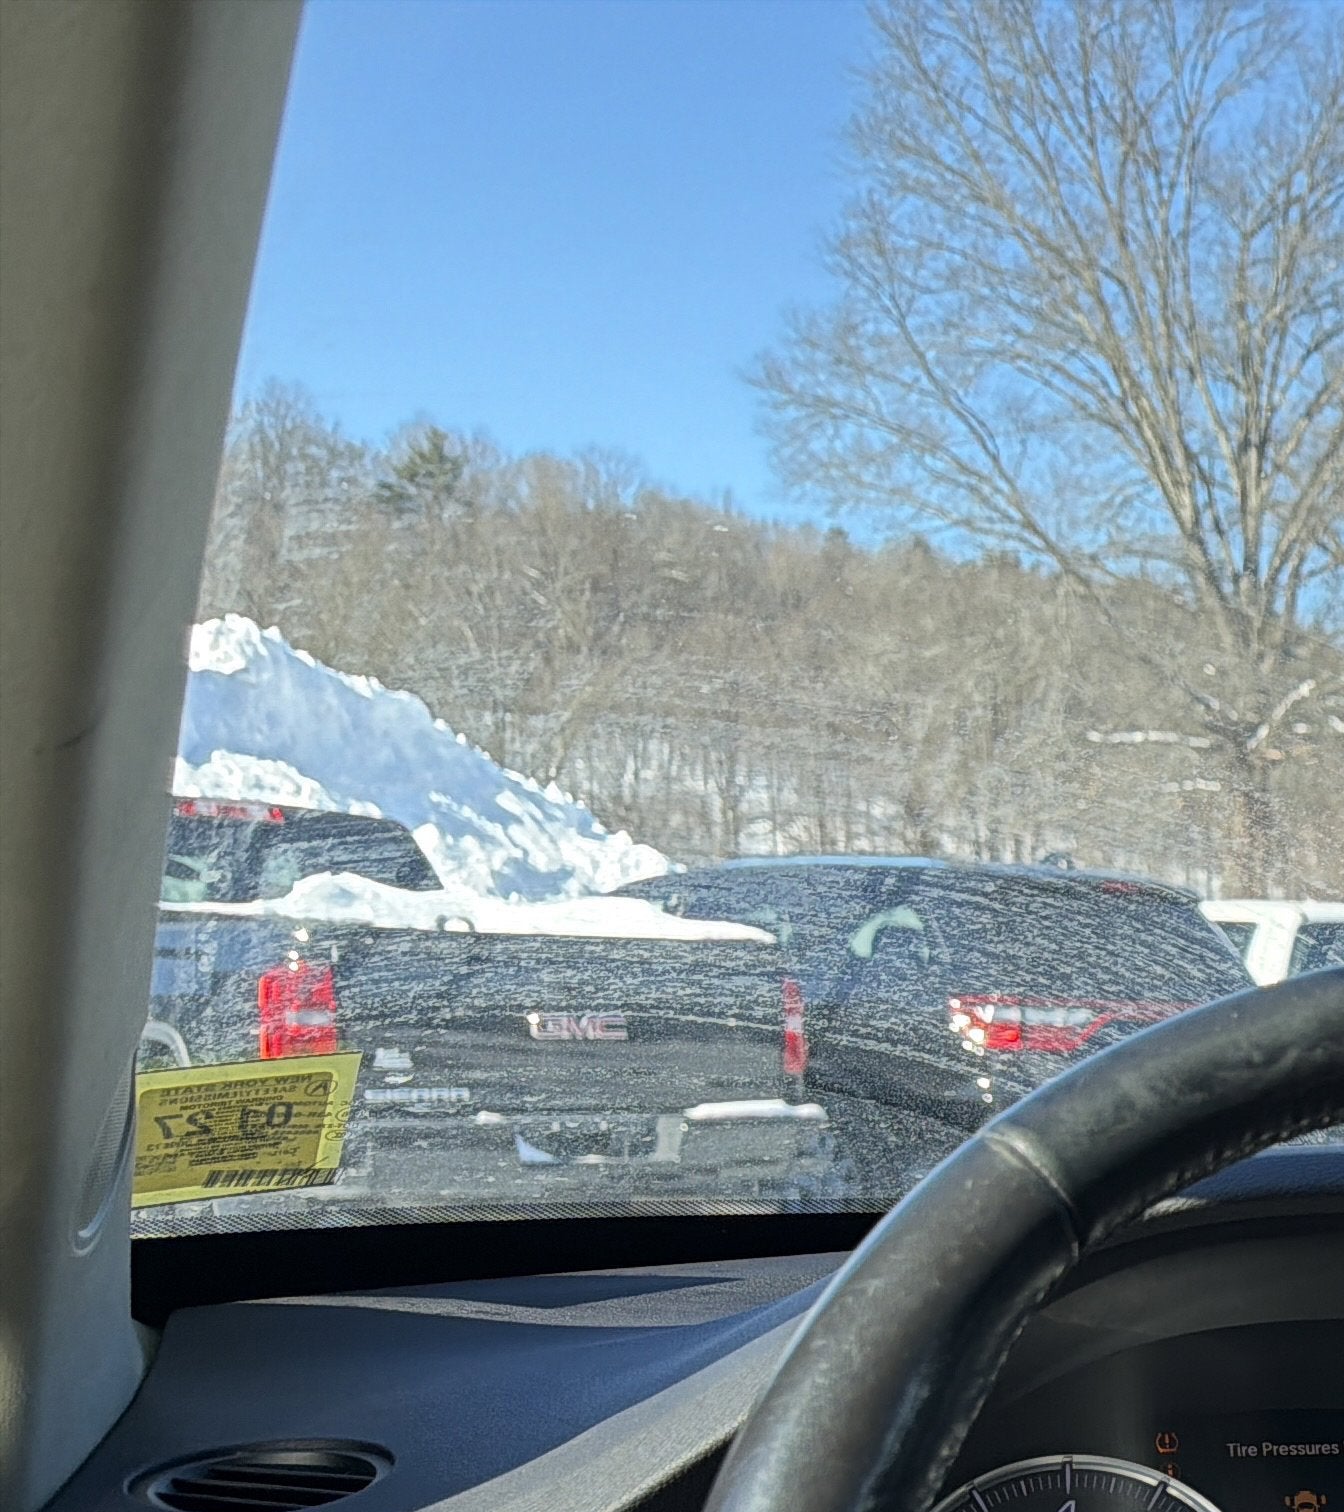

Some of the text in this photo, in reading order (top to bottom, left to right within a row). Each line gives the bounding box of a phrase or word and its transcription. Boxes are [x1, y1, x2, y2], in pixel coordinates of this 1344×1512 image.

[530, 1015, 628, 1041] GMC
[1227, 1442, 1259, 1458] Tire
[1262, 1440, 1340, 1457] Pressures
